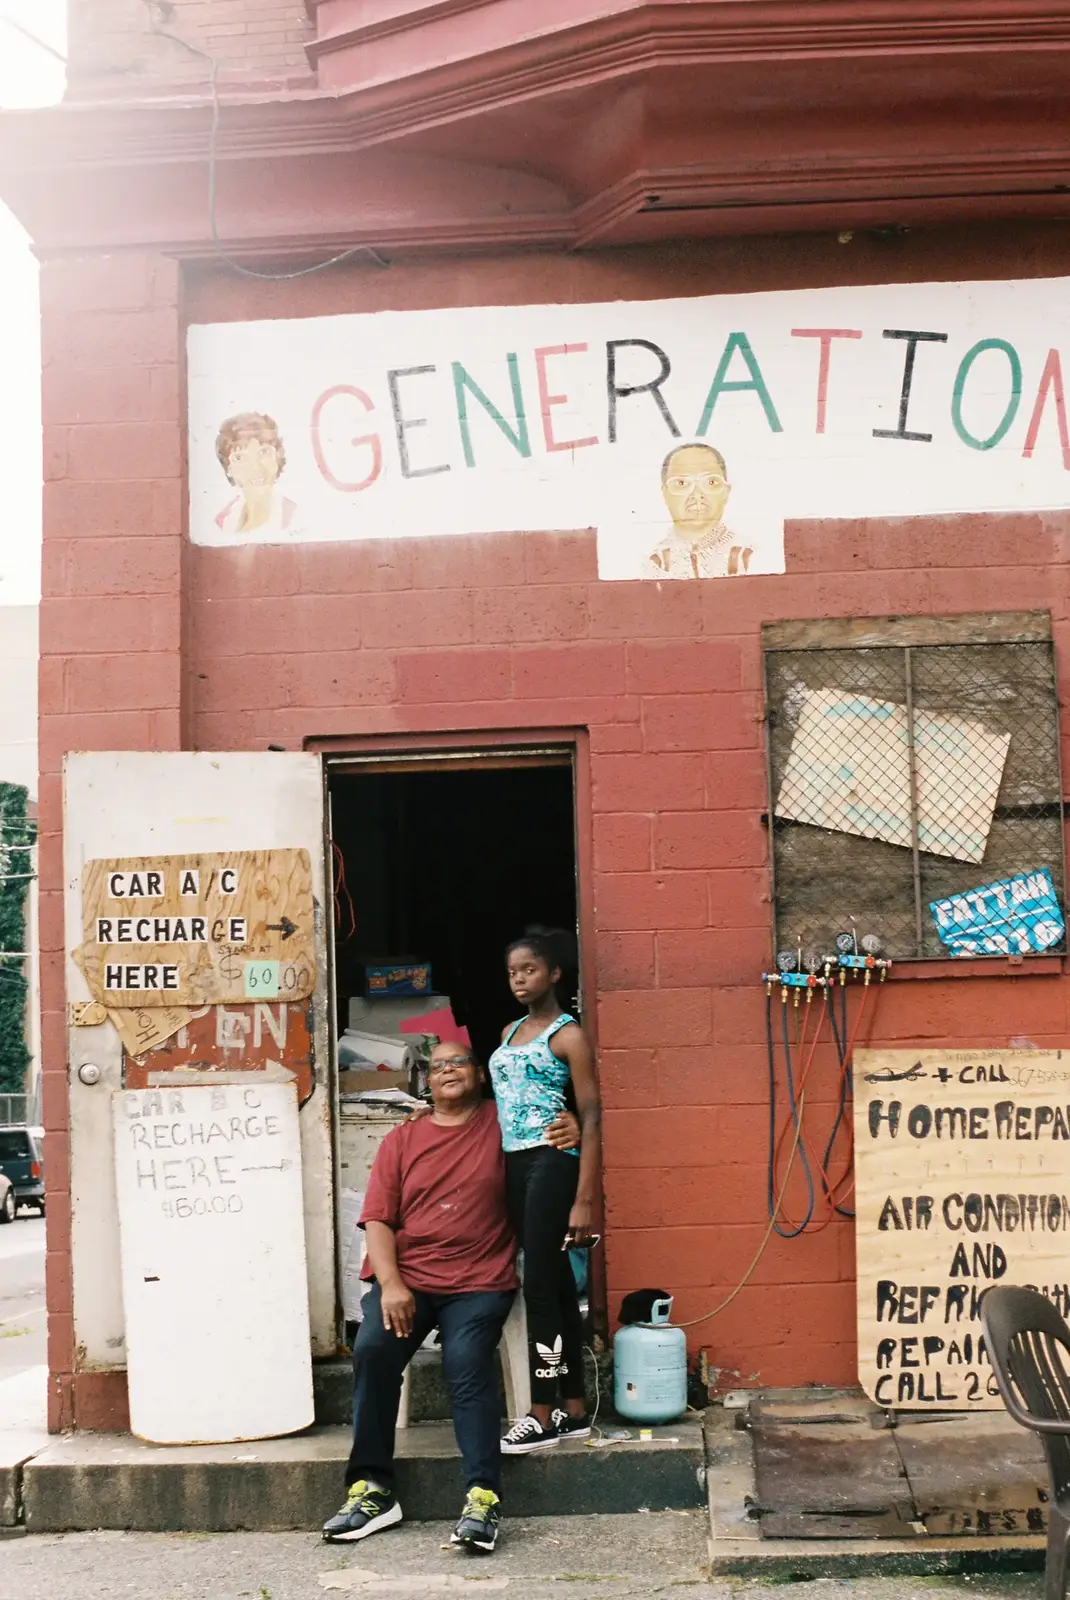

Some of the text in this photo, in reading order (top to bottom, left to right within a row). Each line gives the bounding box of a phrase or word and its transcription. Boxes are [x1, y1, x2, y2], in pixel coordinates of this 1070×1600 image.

[109, 872, 163, 897] CAR
[936, 873, 1050, 927] FATTAH
[98, 917, 246, 943] RECHARGE
[106, 965, 178, 989] HERE
[959, 1063, 1010, 1084] CALL
[129, 1115, 284, 1151] RECHARGE
[994, 1099, 1070, 1141] REPA
[136, 1154, 237, 1191] HERE
[877, 1195, 935, 1231] AIR
[949, 1241, 1008, 1280] AND
[535, 1365, 569, 1379] adidas
[874, 1371, 958, 1405] CALL
